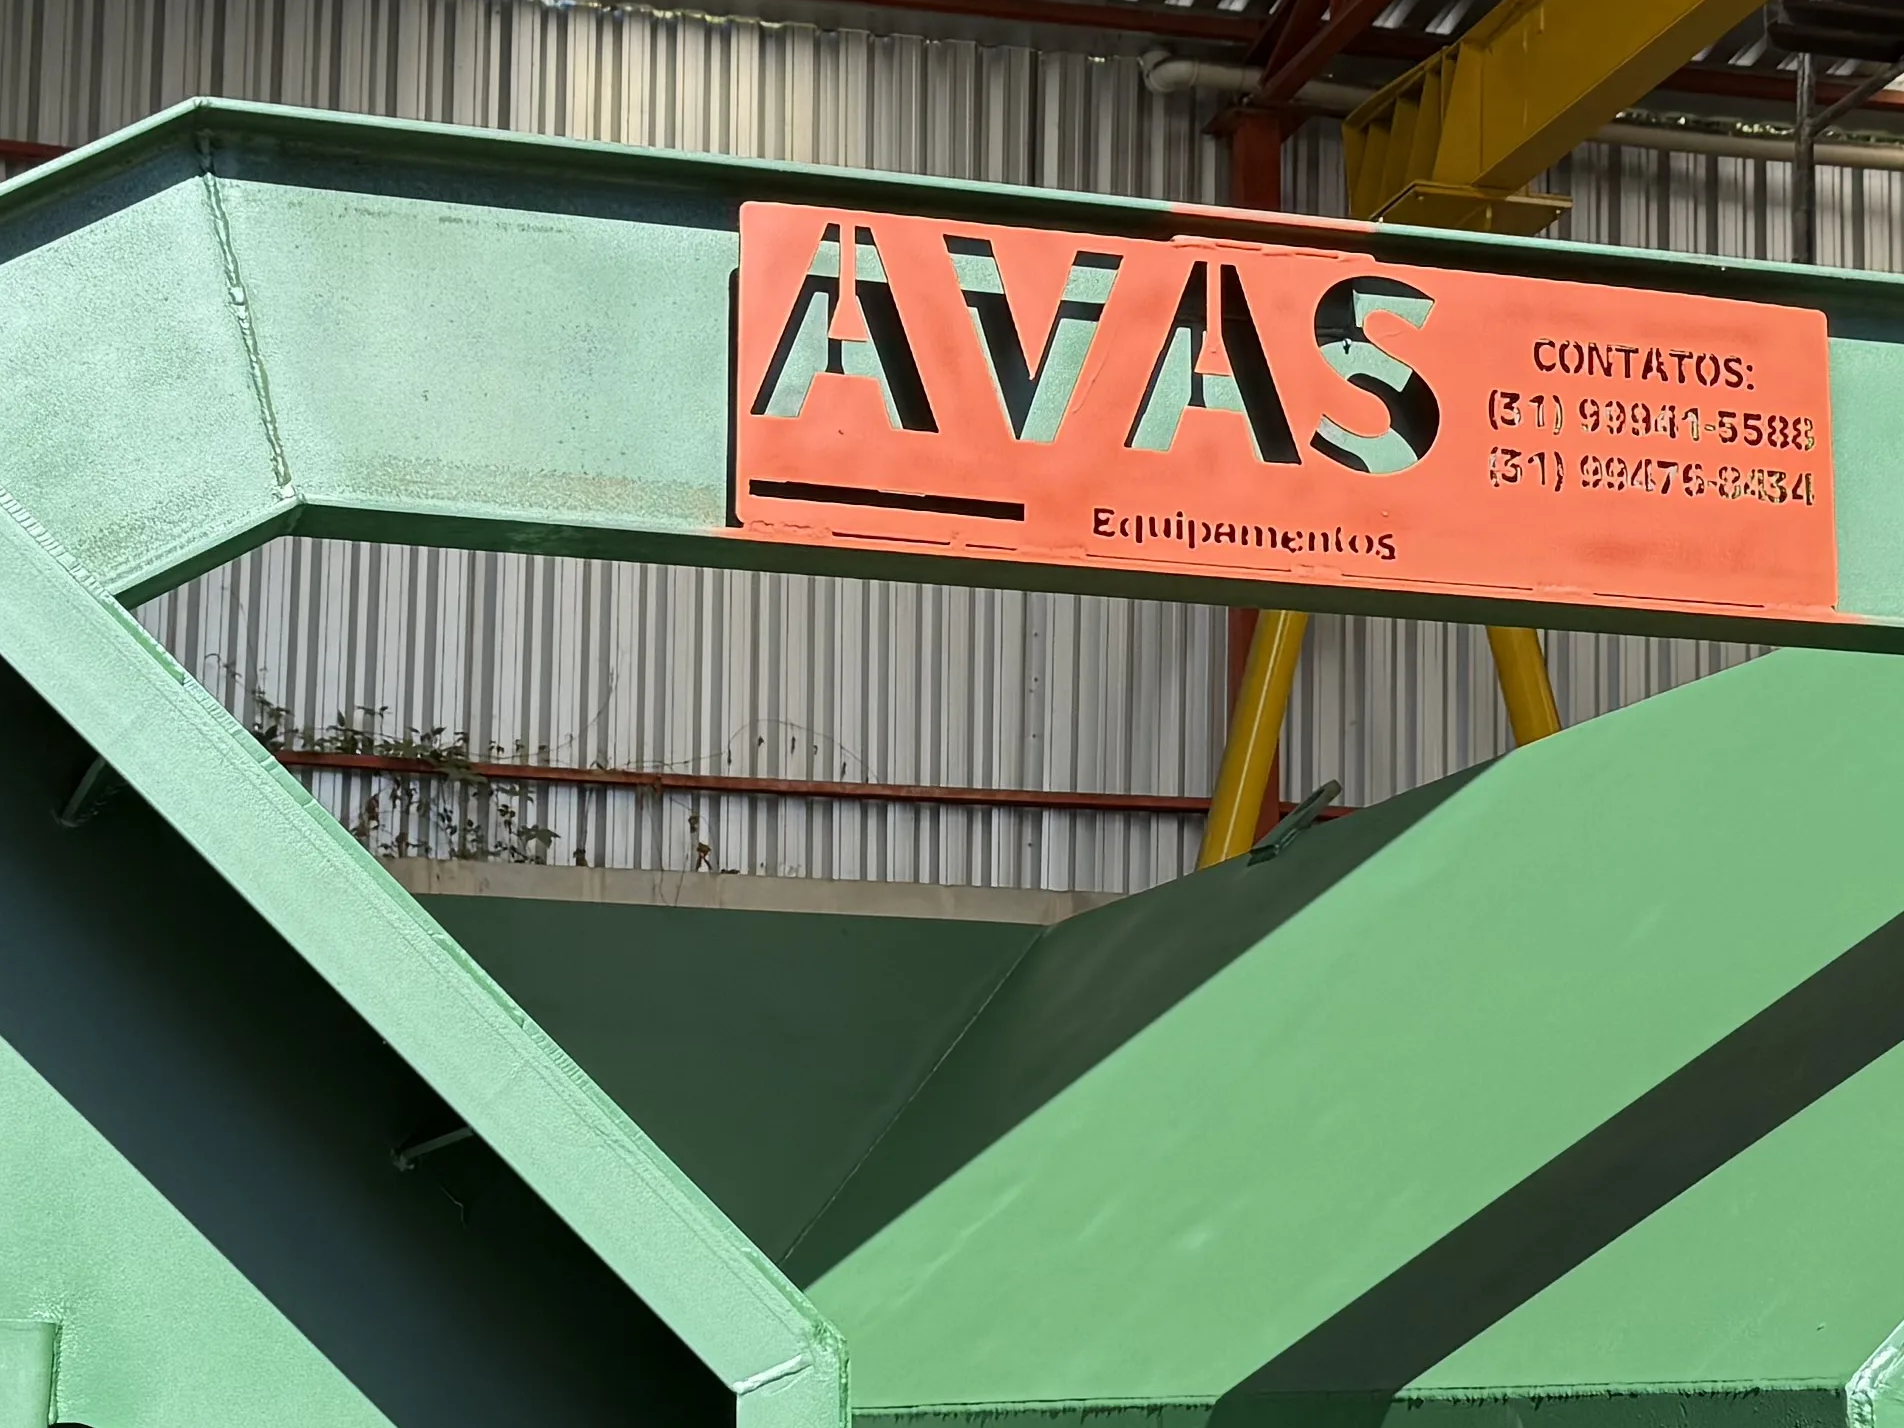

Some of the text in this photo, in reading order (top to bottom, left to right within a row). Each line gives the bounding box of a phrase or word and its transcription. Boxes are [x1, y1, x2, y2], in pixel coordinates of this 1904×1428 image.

[751, 222, 1441, 476] AVAS
[1533, 338, 1756, 390] CONTATOS:
[1489, 390, 1815, 451] (31) 99941-5588
[1489, 446, 1564, 492] (31)
[1092, 507, 1397, 561] Equipamentos
